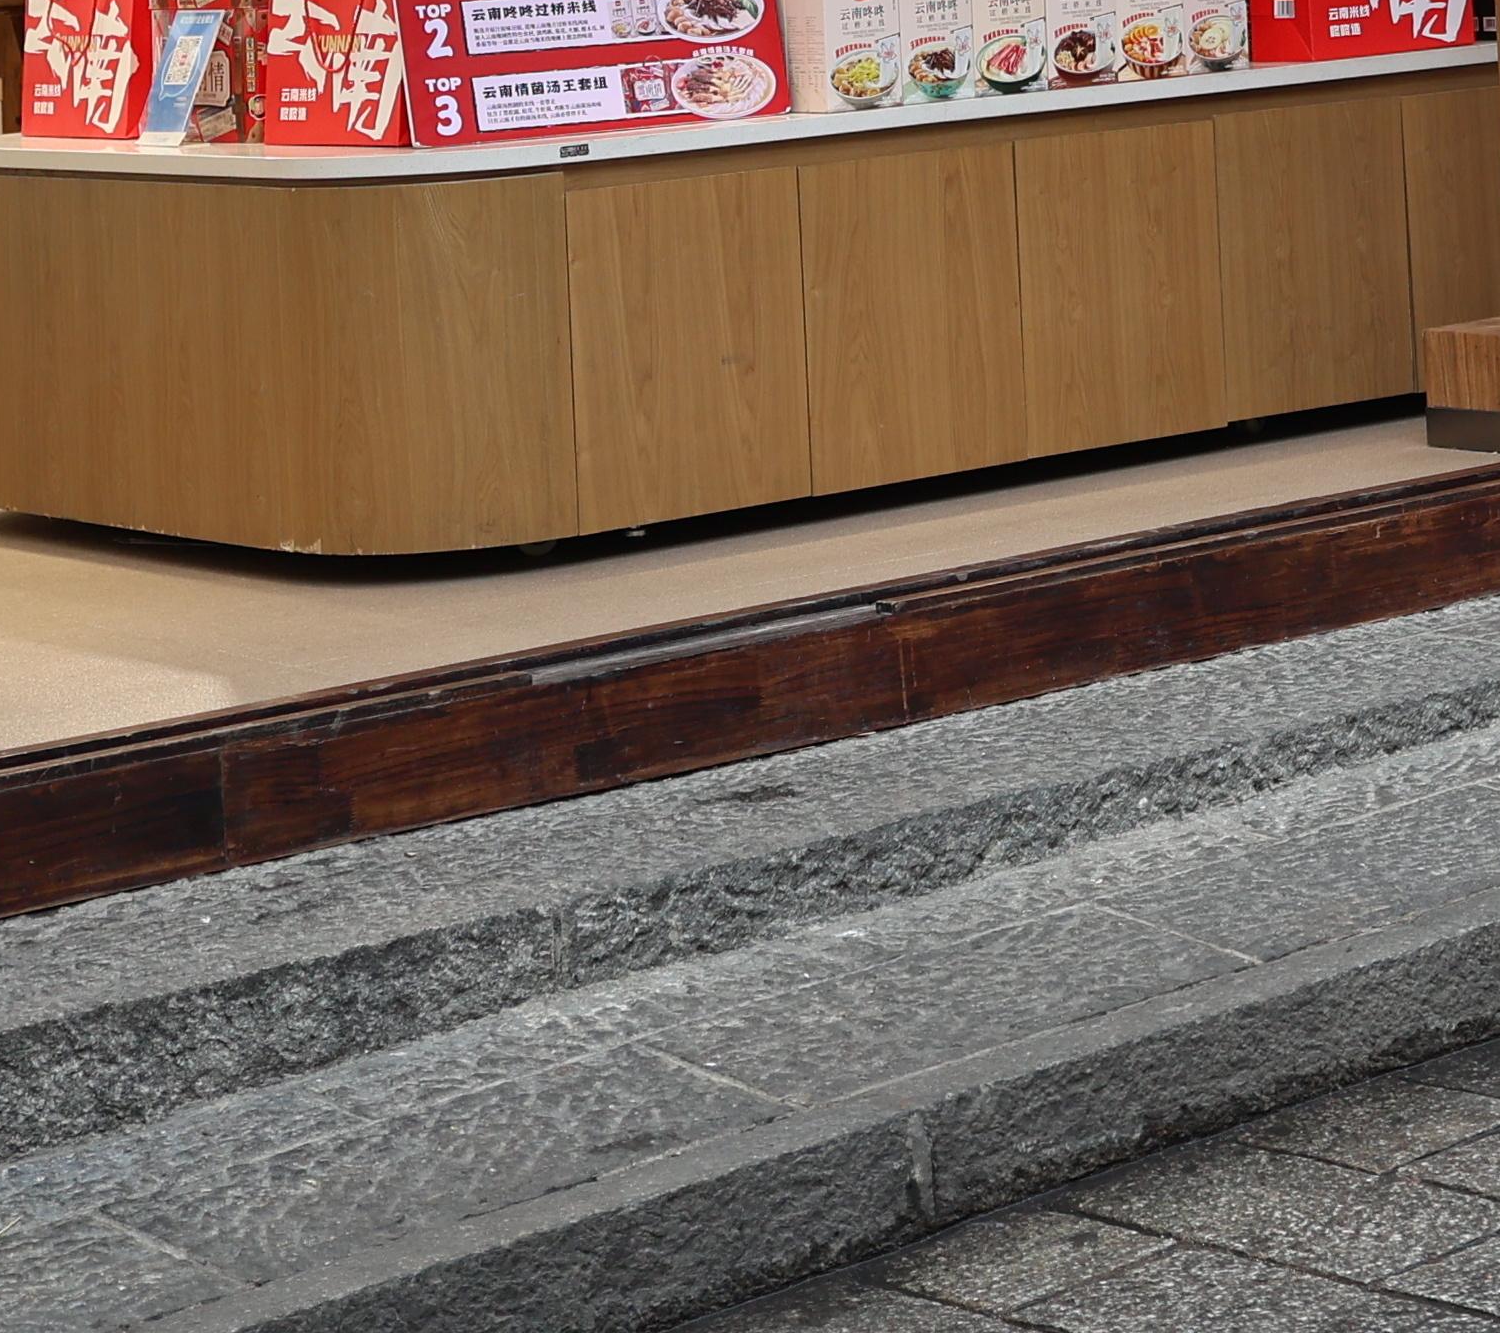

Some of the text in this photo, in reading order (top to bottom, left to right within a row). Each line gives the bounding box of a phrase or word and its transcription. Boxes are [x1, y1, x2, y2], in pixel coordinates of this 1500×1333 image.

[414, 3, 452, 19] TOP
[471, 0, 598, 22] 云南咚咚过桥米线
[839, 4, 885, 21] 云南咚咚
[915, 0, 958, 15] 云南咚咚
[1328, 5, 1370, 21] 云南米线
[423, 18, 455, 59] 2
[424, 76, 462, 93] TOP
[482, 76, 609, 99] 云南情菌汤王套组
[280, 87, 317, 102] 云南米线
[433, 94, 463, 137] 3
